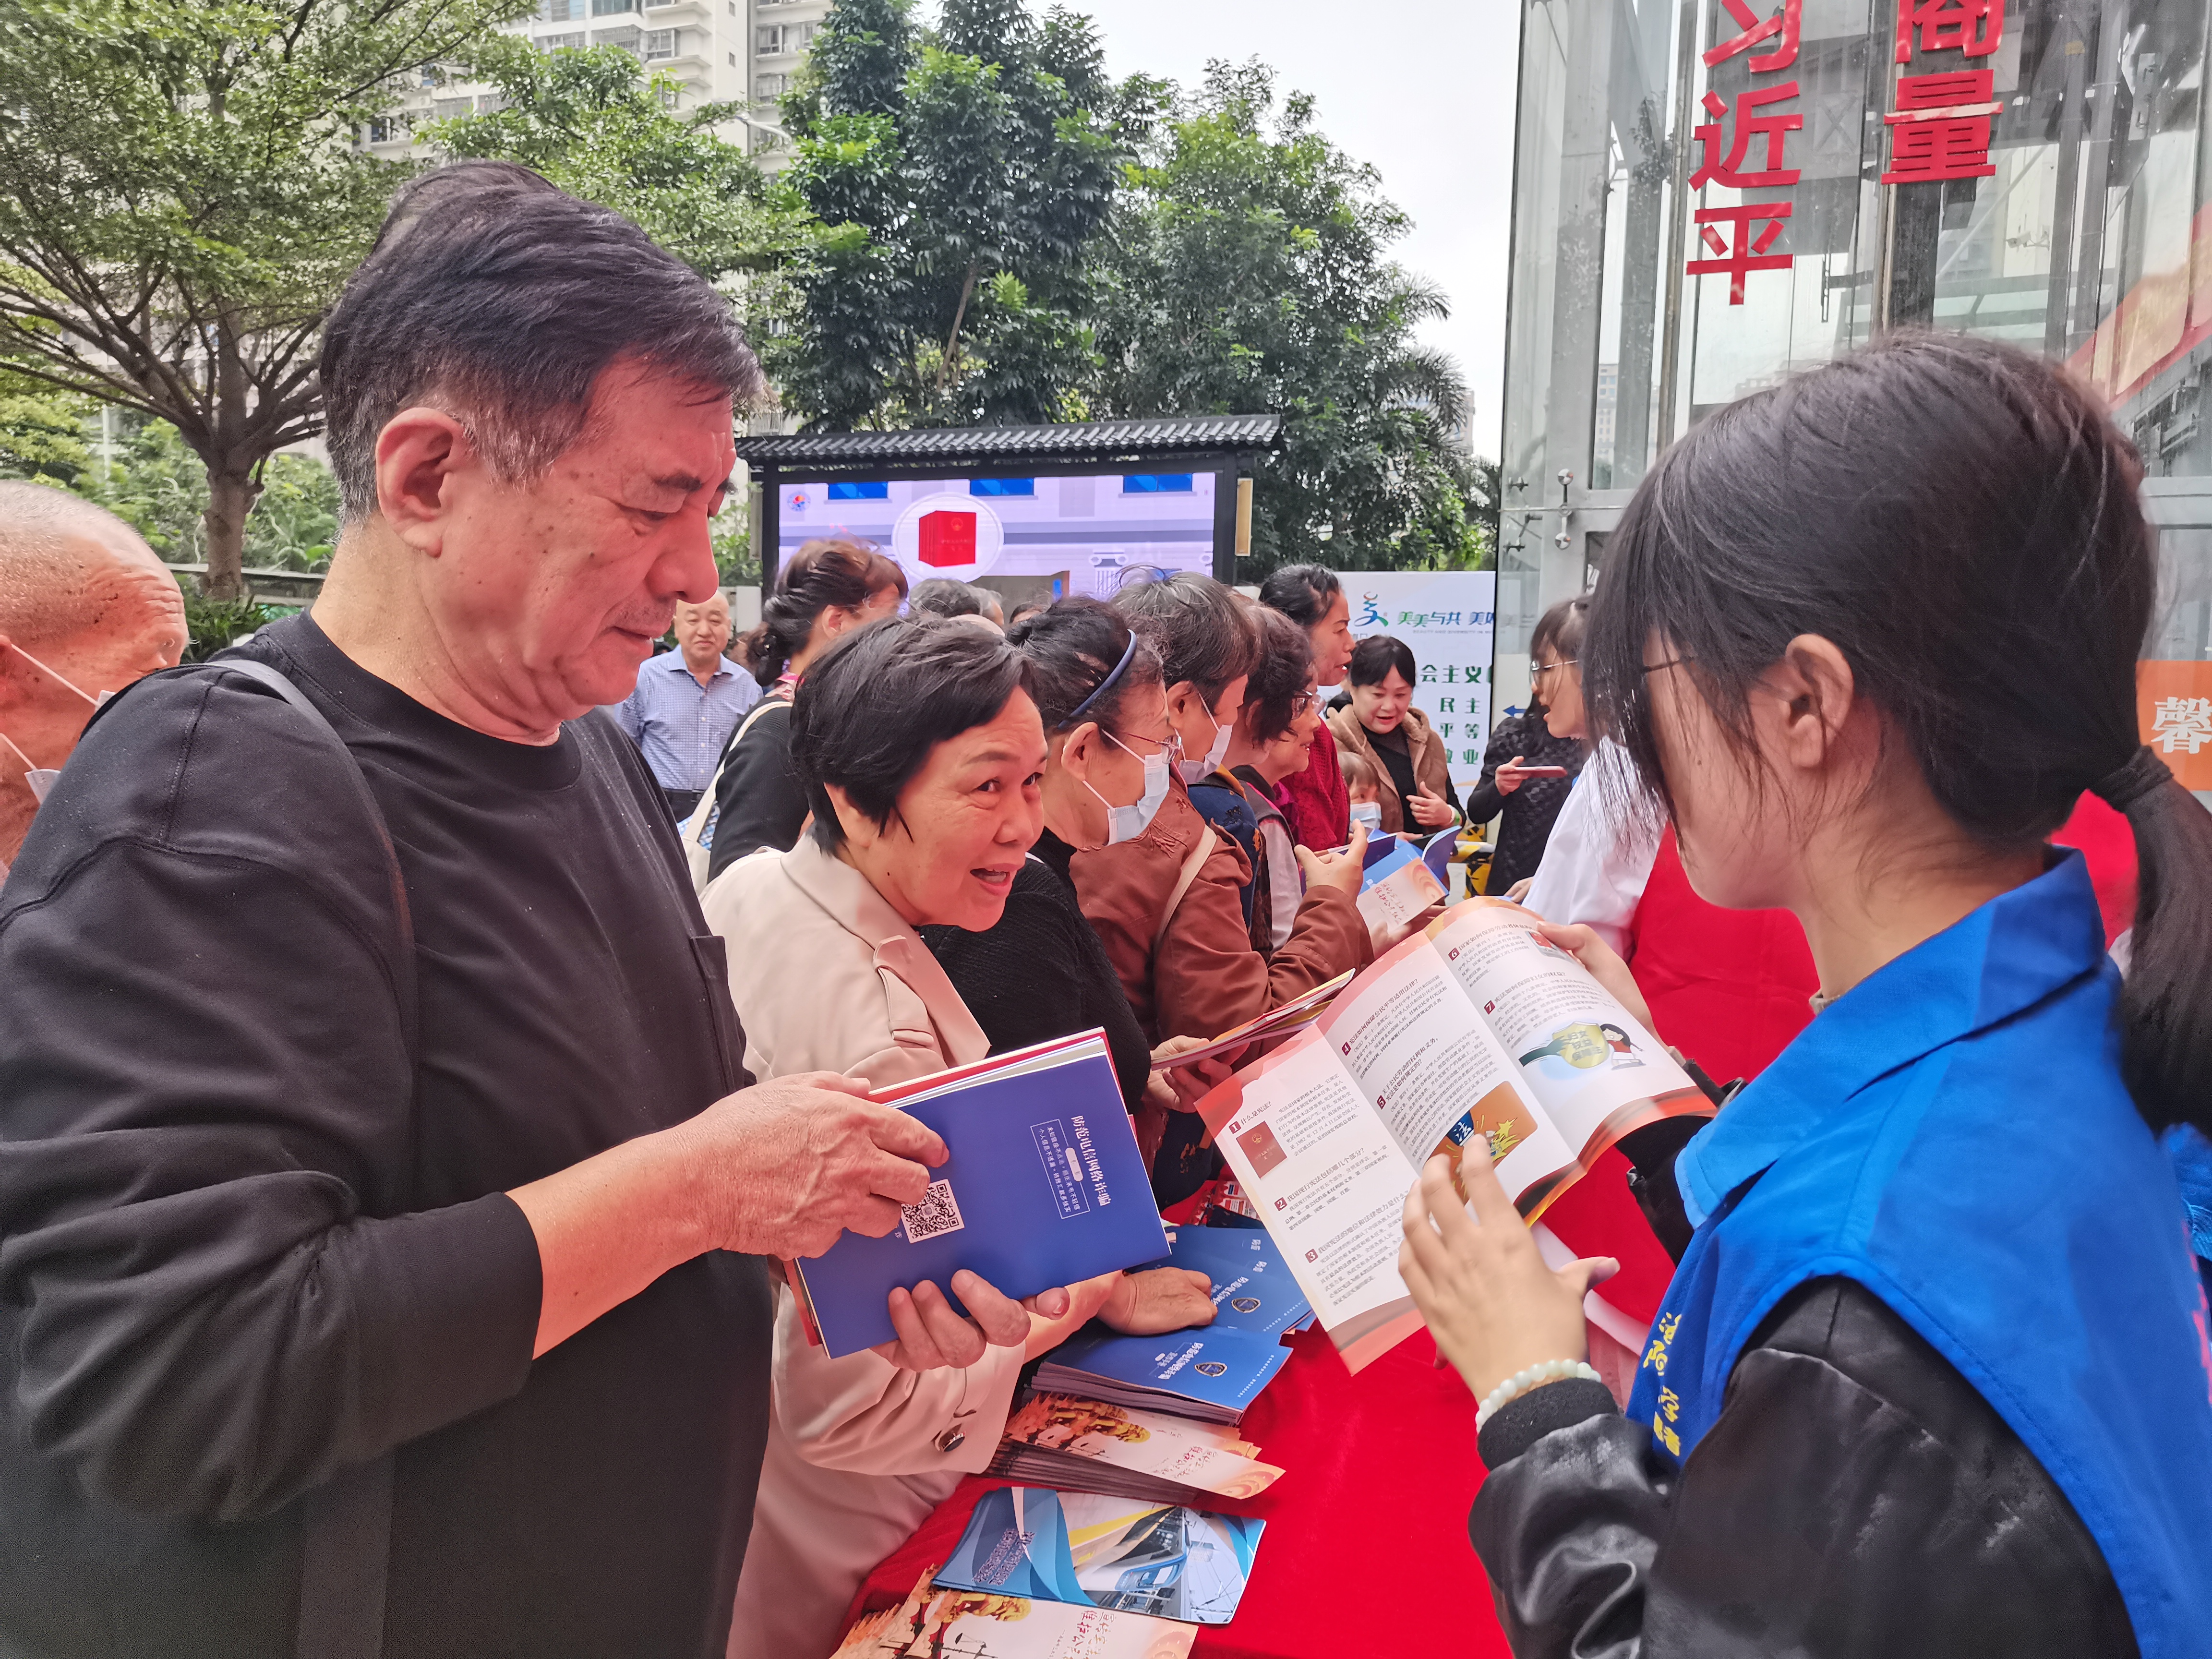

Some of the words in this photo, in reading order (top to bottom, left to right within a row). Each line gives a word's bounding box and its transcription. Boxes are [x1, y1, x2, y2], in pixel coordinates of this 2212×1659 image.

[1398, 611, 1461, 627] 美美与共
[1420, 665, 1491, 684] 会主义
[2151, 697, 2212, 754] 馨
[1450, 950, 1458, 959] 6
[1486, 1003, 1493, 1012] 7
[1231, 1123, 1238, 1132] 1
[1240, 1101, 1272, 1125] 什么是宪法?
[1453, 1121, 1472, 1142] 法
[1070, 1114, 1112, 1207] 防范电信网络诈骗
[1276, 1199, 1285, 1208] 2
[1307, 1251, 1316, 1260] 3
